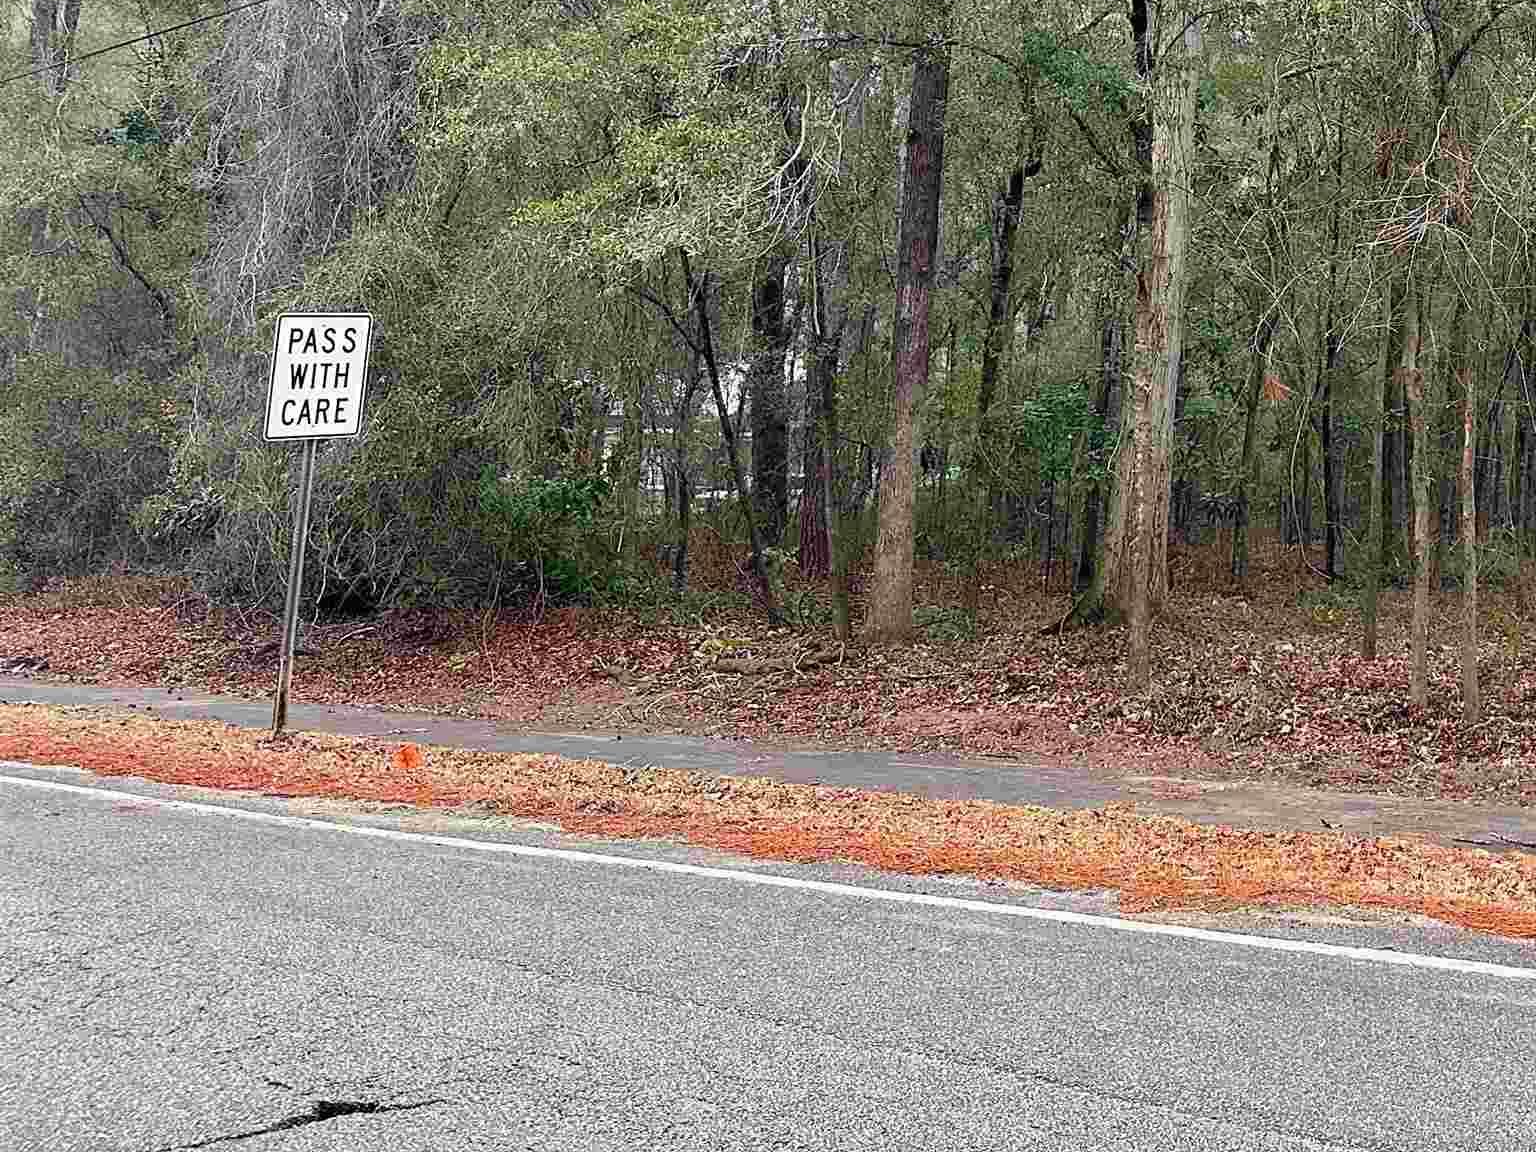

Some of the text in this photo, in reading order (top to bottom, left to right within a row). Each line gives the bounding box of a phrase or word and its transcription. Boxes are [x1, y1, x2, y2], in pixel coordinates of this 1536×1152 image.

[288, 328, 357, 354] PASS
[290, 363, 350, 390] WITH
[281, 398, 349, 426] CARE
